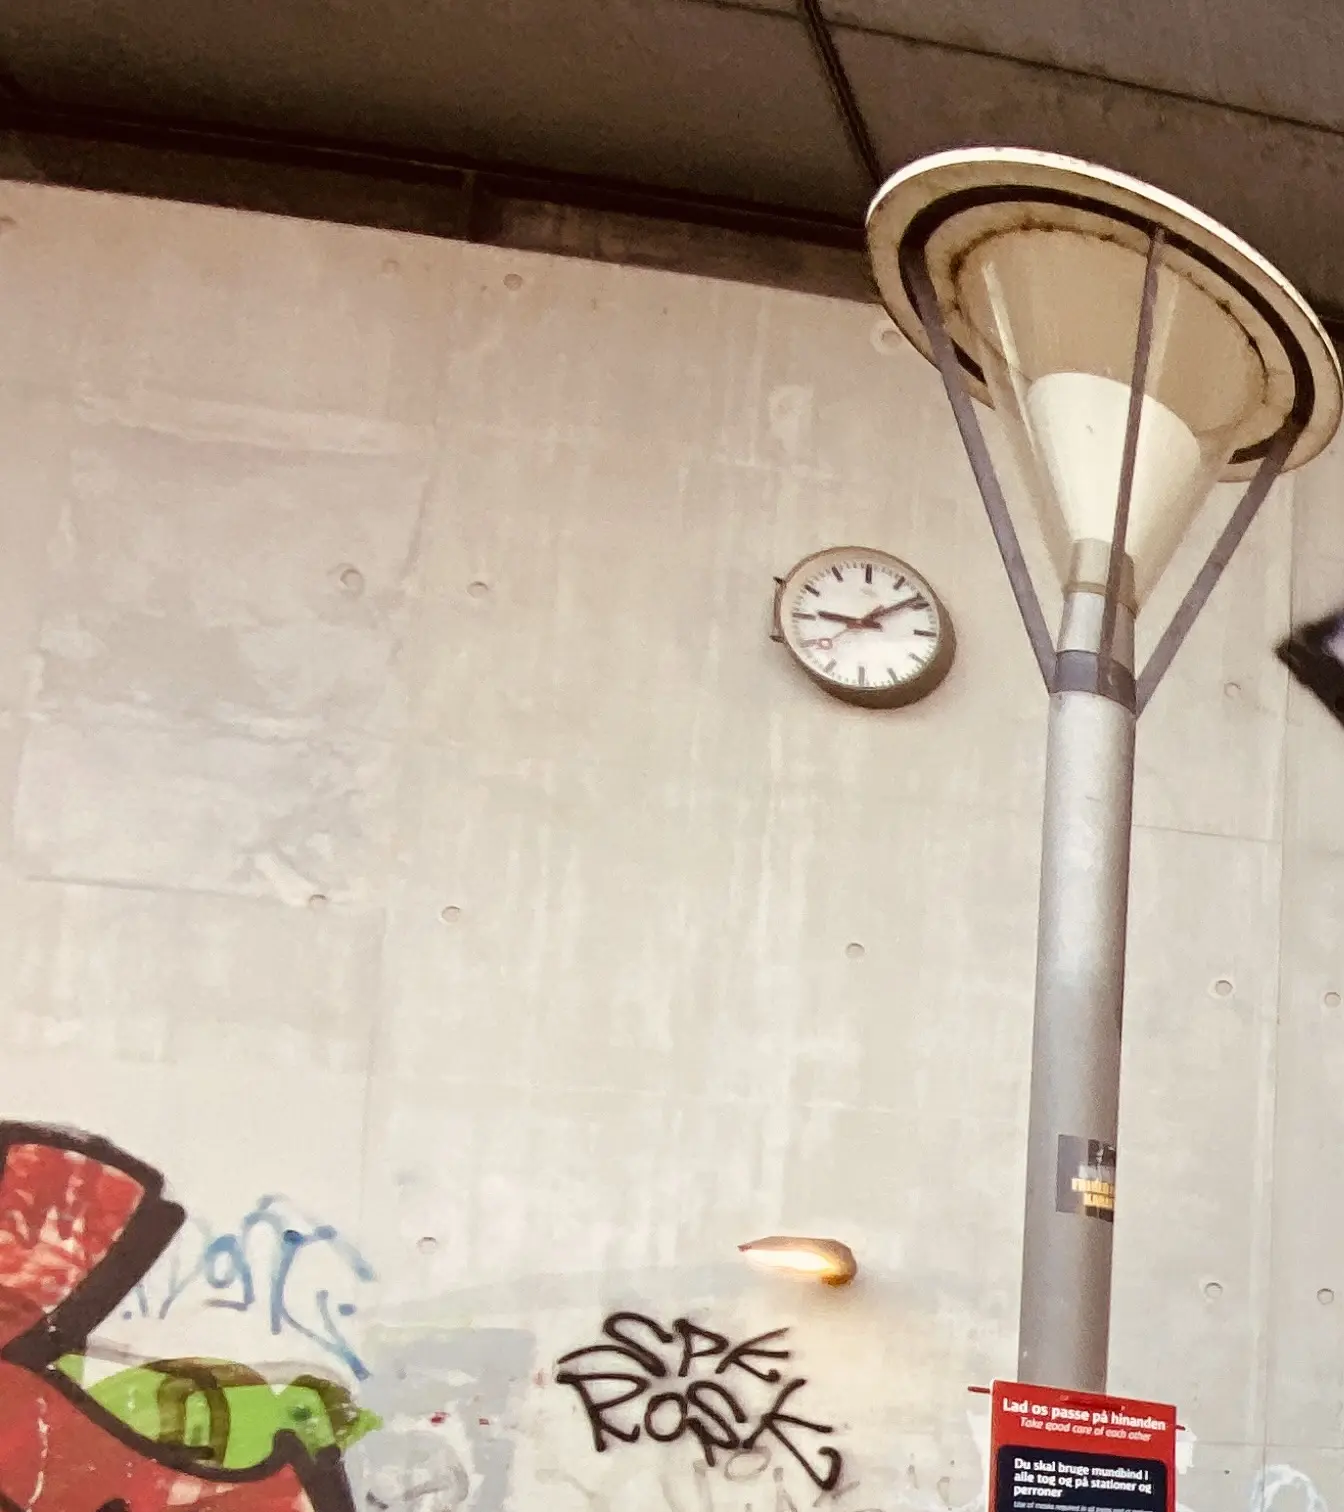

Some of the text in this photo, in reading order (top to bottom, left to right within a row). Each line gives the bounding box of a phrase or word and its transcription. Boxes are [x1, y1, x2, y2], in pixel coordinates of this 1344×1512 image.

[1003, 1398, 1166, 1431] Lad os passe på hinanden
[1020, 1416, 1152, 1442] Take good care of each other
[1014, 1457, 1031, 1470] Du
[1033, 1459, 1055, 1472] skal
[1058, 1461, 1089, 1476] bruge
[1091, 1467, 1143, 1480] mundbind
[1013, 1485, 1063, 1498] perroner
[1014, 1471, 1152, 1494] alle tog og på stationer og
